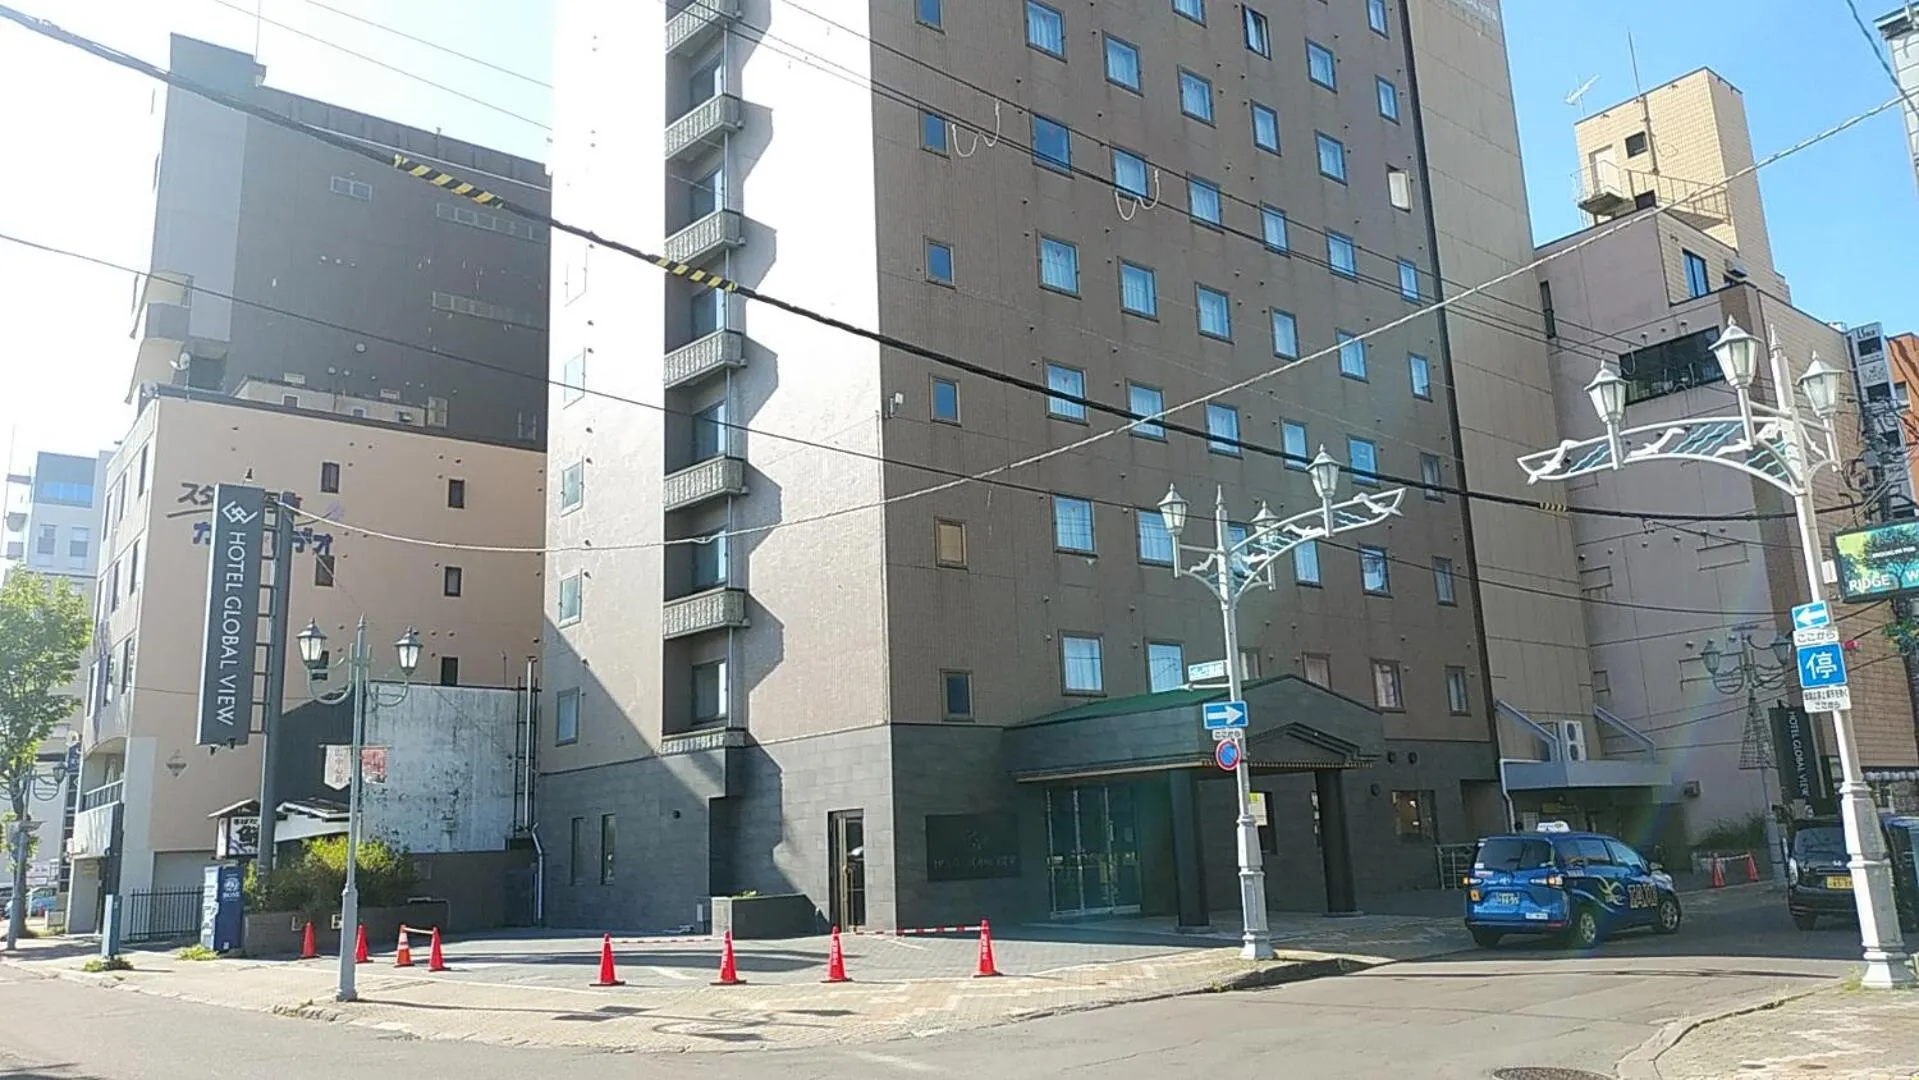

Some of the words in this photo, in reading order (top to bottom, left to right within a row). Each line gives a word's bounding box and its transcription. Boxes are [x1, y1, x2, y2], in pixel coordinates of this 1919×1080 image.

[226, 531, 247, 592] HOTEL
[1849, 574, 1890, 592] RIDGE
[219, 595, 242, 670] GLOBAL
[1797, 631, 1836, 643] ここから
[1806, 651, 1837, 680] 停
[215, 674, 237, 726] VIEW
[1788, 711, 1800, 739] HOTEL
